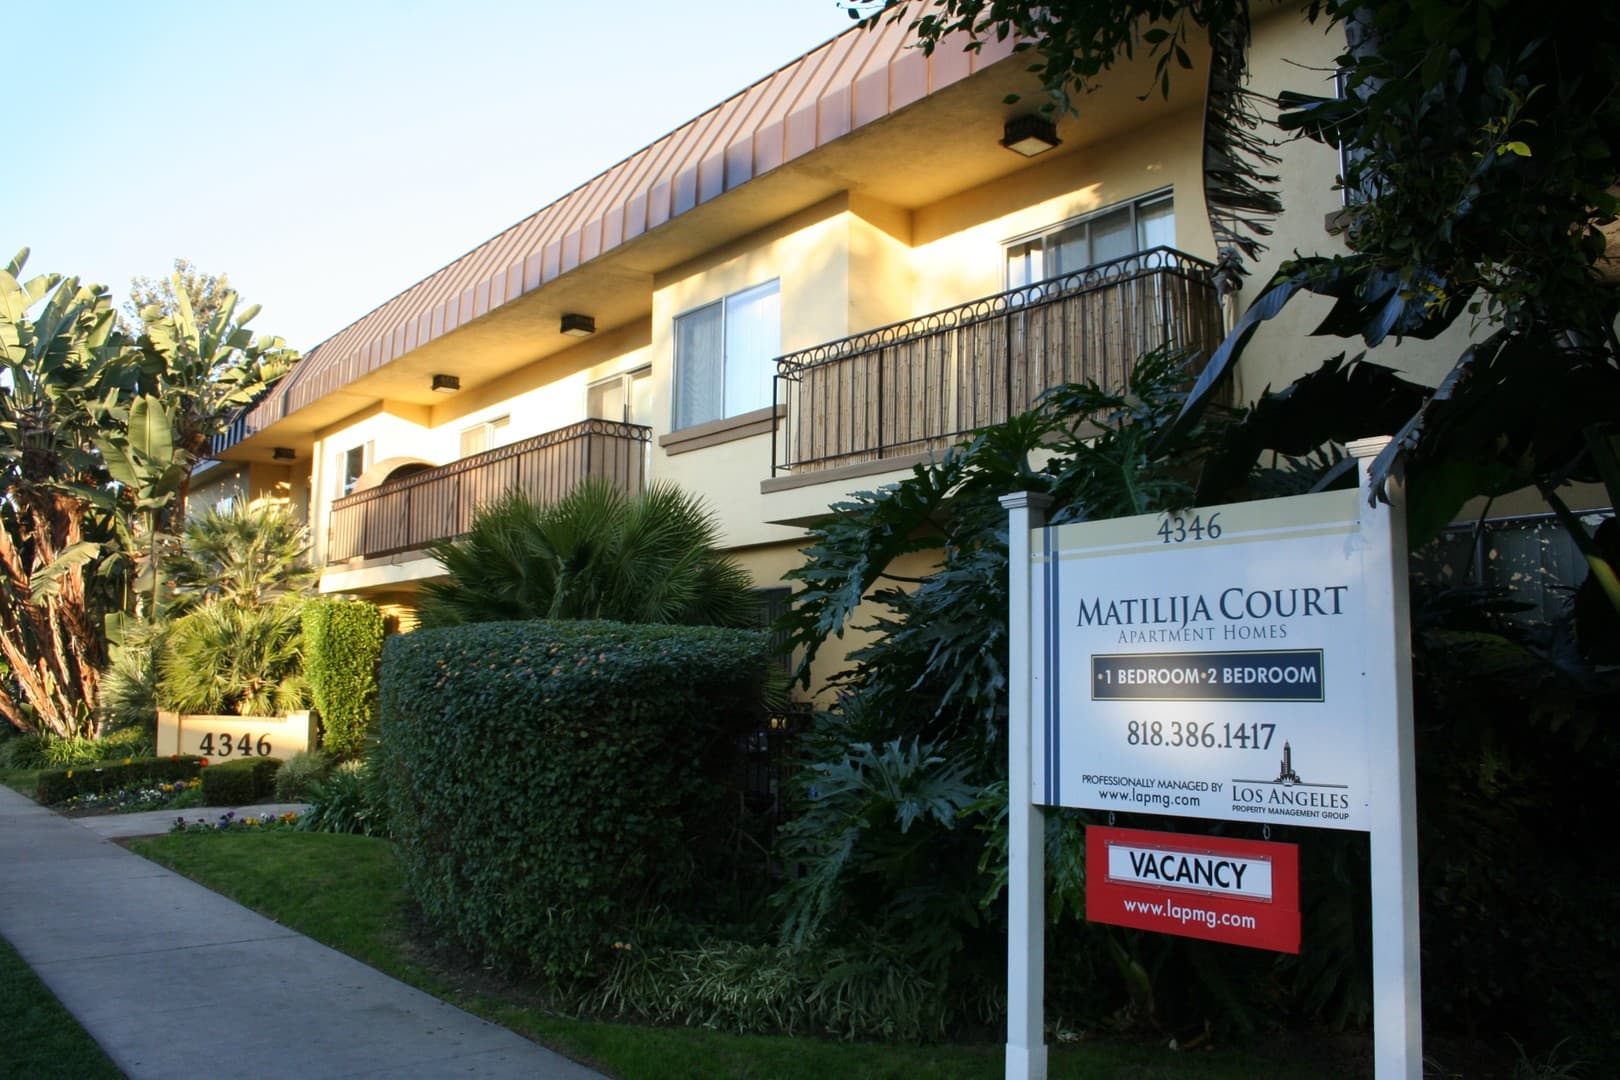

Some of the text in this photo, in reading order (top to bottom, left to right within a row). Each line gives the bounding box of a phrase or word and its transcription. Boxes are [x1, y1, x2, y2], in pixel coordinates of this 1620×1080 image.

[1157, 512, 1222, 543] 4346
[1077, 585, 1348, 630] MATILIJA COURT
[1118, 623, 1287, 645] APARTMENT HOMES
[1104, 665, 1317, 685] 1 BEDROOM 2 BEDROOM
[200, 732, 273, 757] 4346
[1127, 720, 1276, 750] 818.386.1417
[1082, 774, 1224, 793] PROFESSIONALLY MANAGED BY
[1098, 787, 1200, 808] www.lapmg.com
[1232, 785, 1349, 809] LOS ANGELES
[1232, 804, 1350, 820] PROPERTY MANAGEMENT GROUP
[1129, 850, 1248, 890] VACANCY
[1123, 898, 1256, 930] www.lapmg.com
